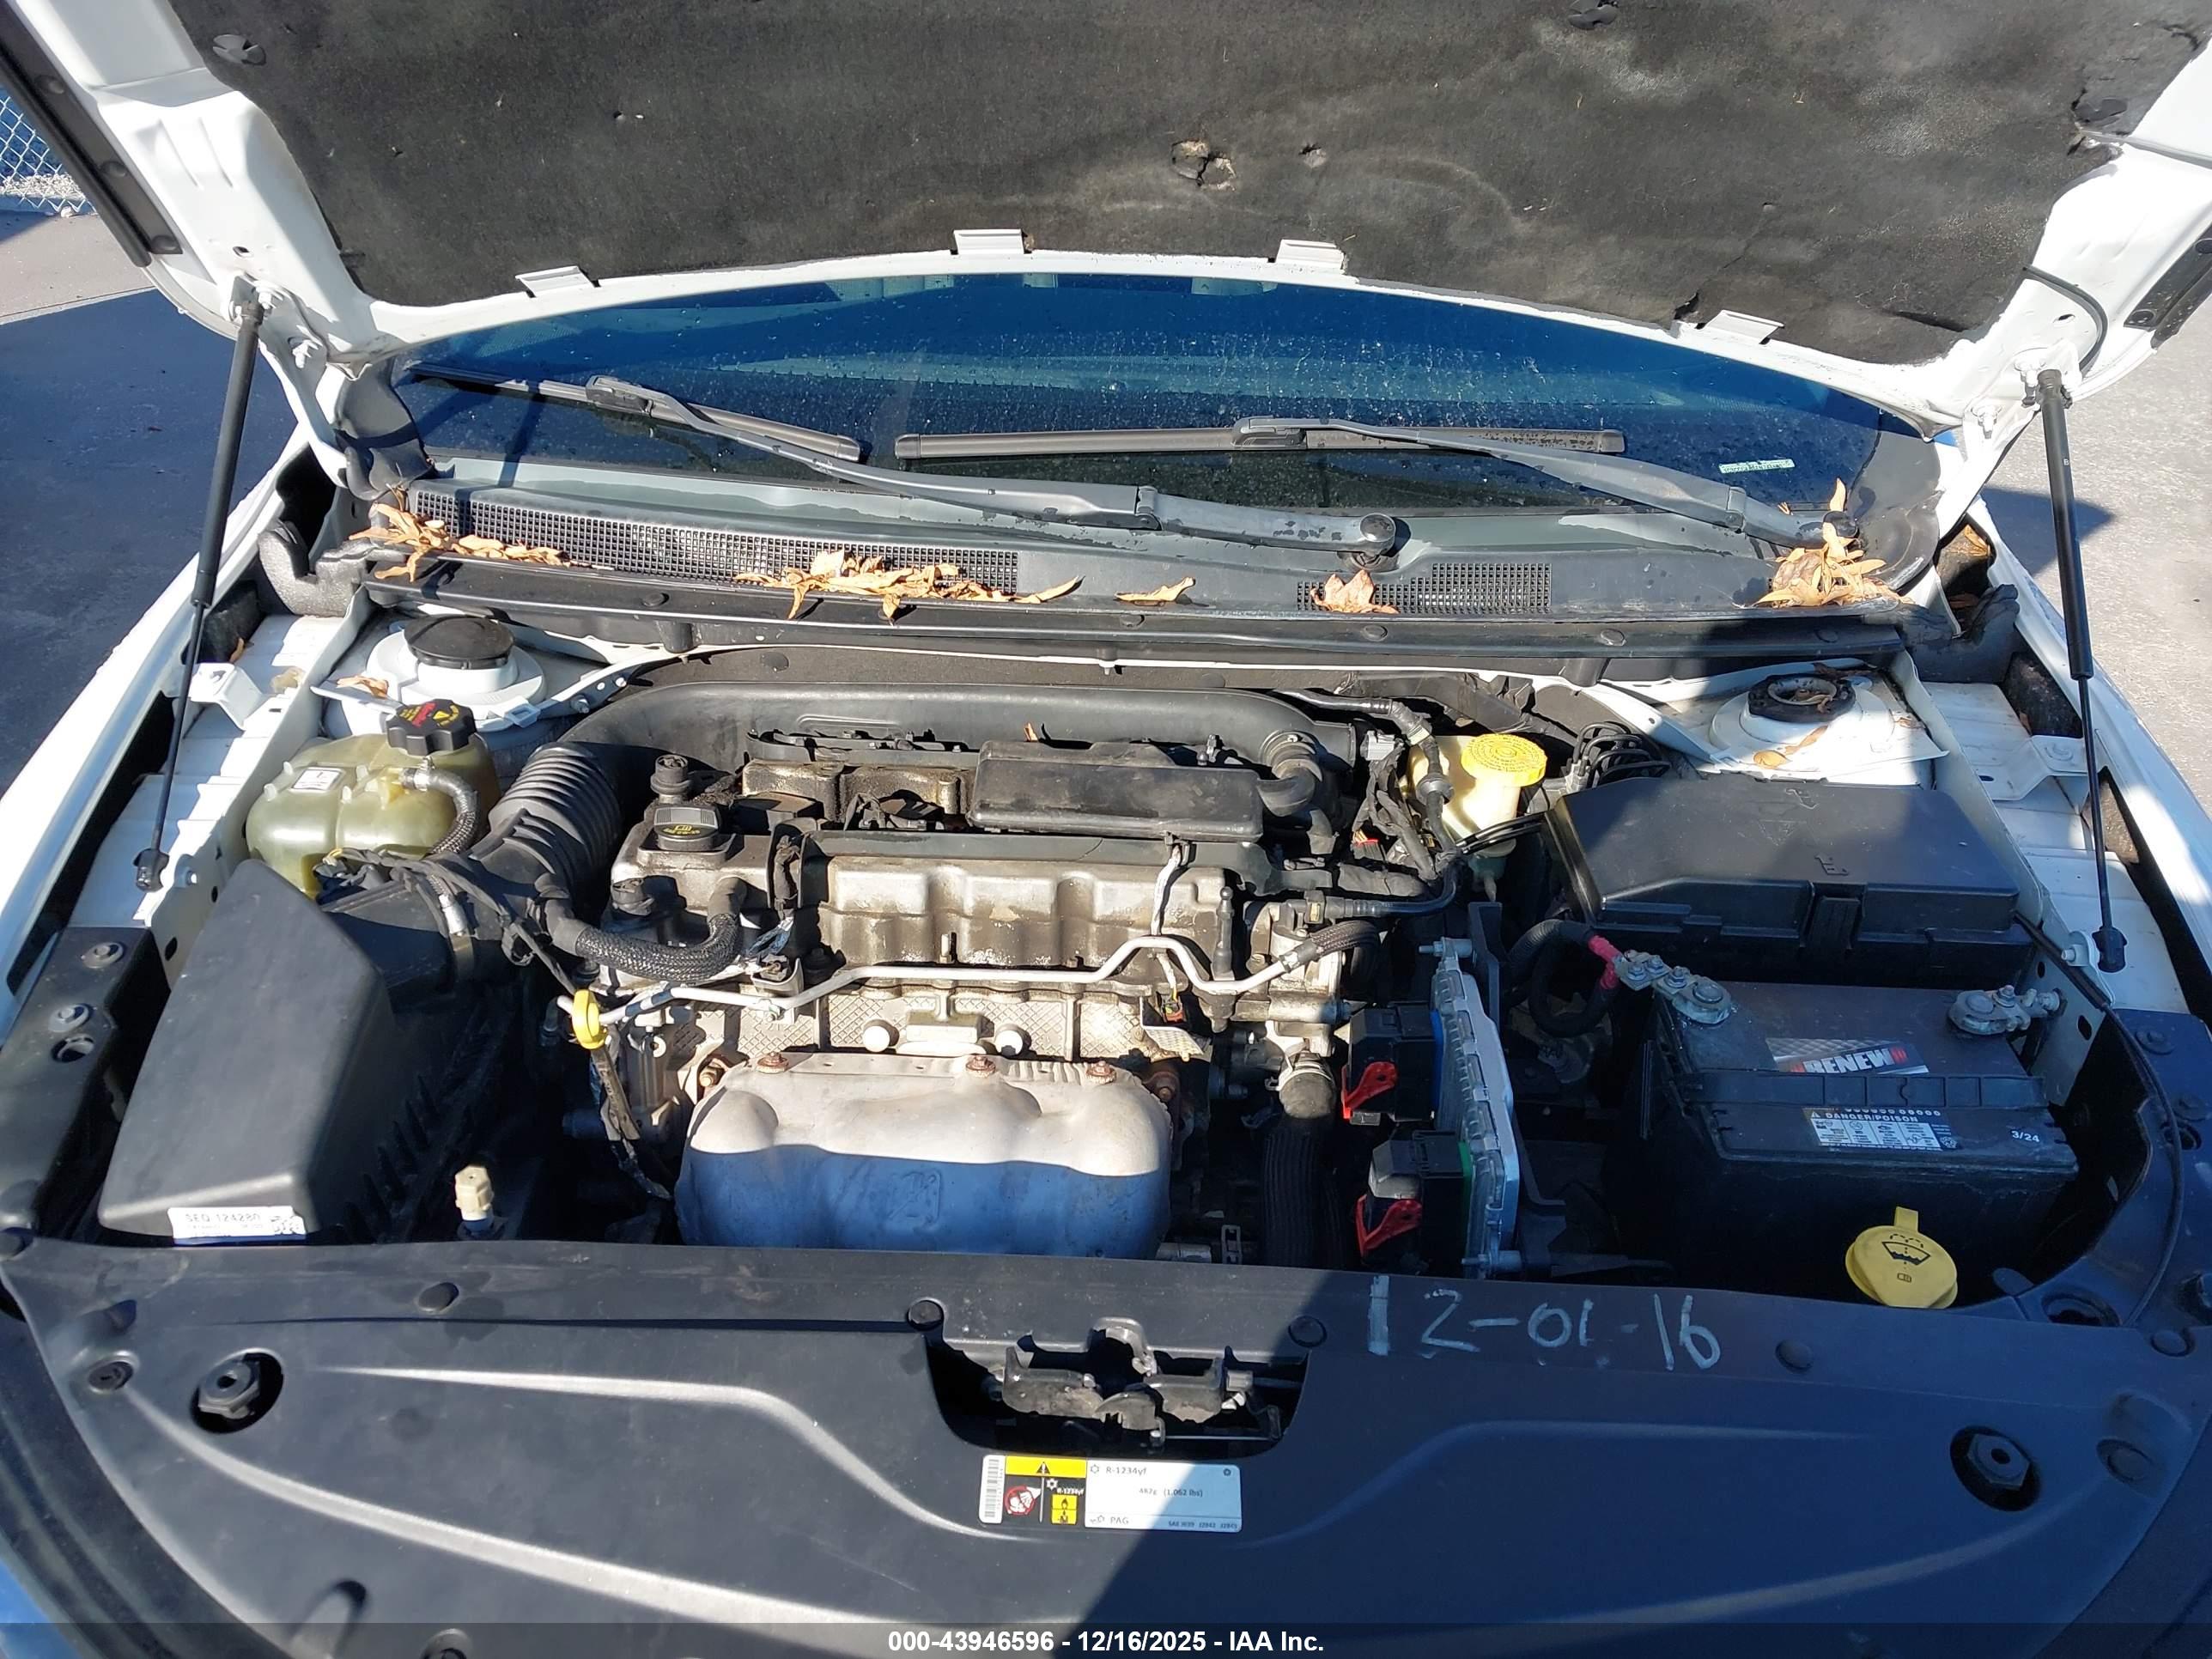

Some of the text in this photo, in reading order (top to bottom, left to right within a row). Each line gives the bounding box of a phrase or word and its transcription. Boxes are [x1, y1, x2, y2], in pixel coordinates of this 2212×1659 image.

[1802, 1048, 1896, 1074] RENEW
[1825, 1112, 1918, 1122] DANGER/POISON
[2011, 1130, 2040, 1143] 3/24
[1105, 1466, 1147, 1476] R-1234yf
[1110, 1516, 1129, 1525] PAG
